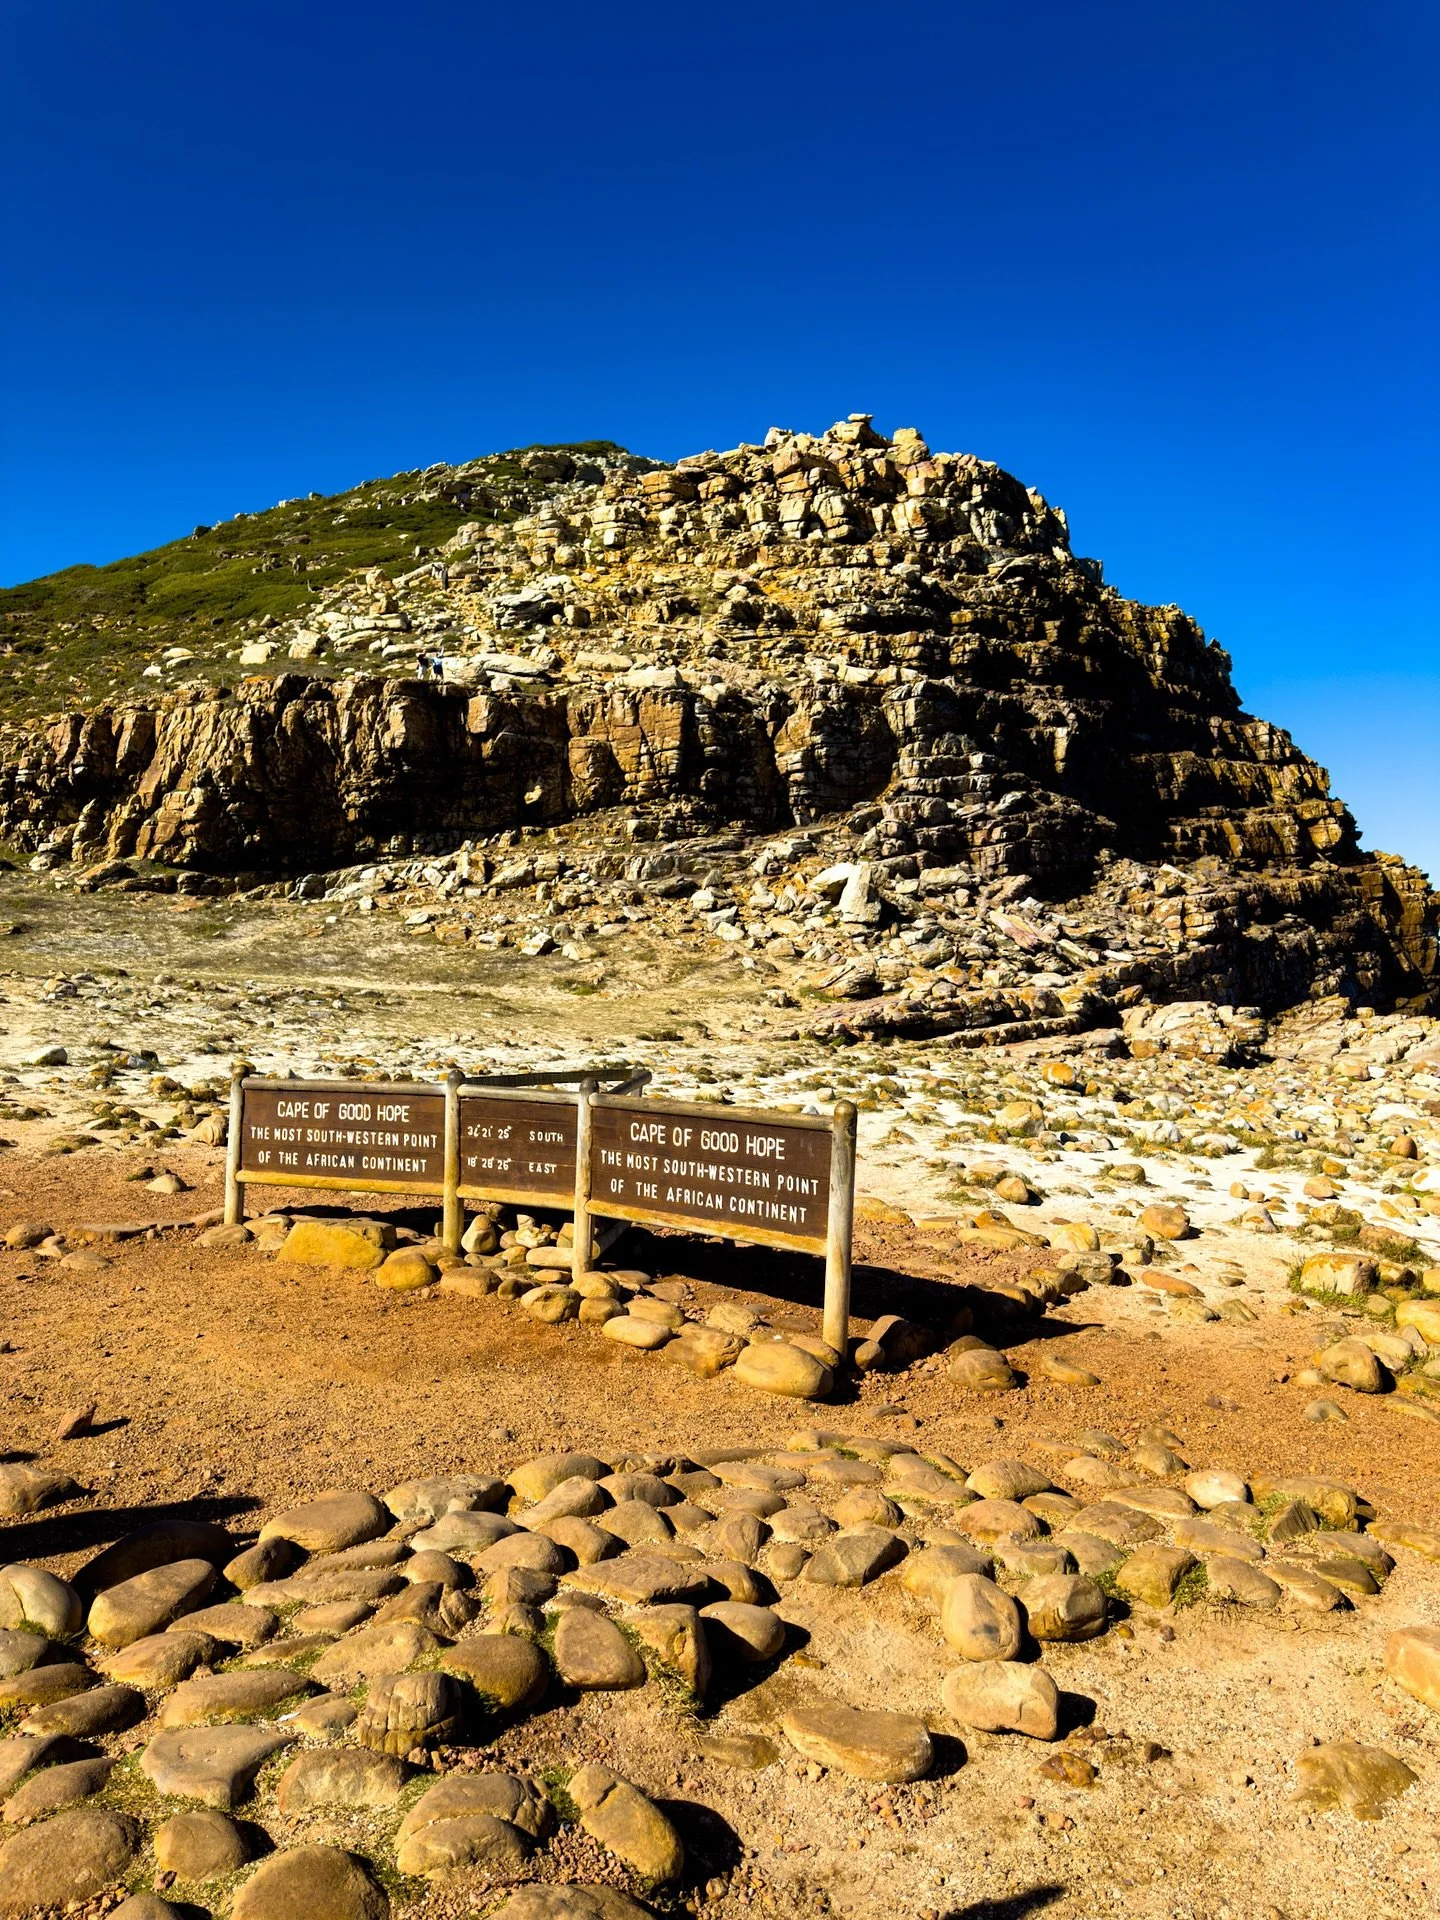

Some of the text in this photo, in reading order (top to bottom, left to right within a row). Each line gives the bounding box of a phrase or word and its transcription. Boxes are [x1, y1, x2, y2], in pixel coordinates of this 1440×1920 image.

[277, 1101, 410, 1122] CAPE OF GOOD HOPE
[251, 1125, 438, 1148] THE MOST SOUTH-WESTERN POINT
[529, 1131, 564, 1143] SOUTH
[630, 1122, 785, 1160] CAPE OF GOOD HOPE
[258, 1151, 427, 1173] OF THE AFRICAN CONTINENT
[528, 1162, 557, 1174] EAST
[601, 1150, 819, 1195] THE MOST SOUTH-WESTERN POINT
[611, 1179, 808, 1223] OF THE AFRICAN CONTINENT
